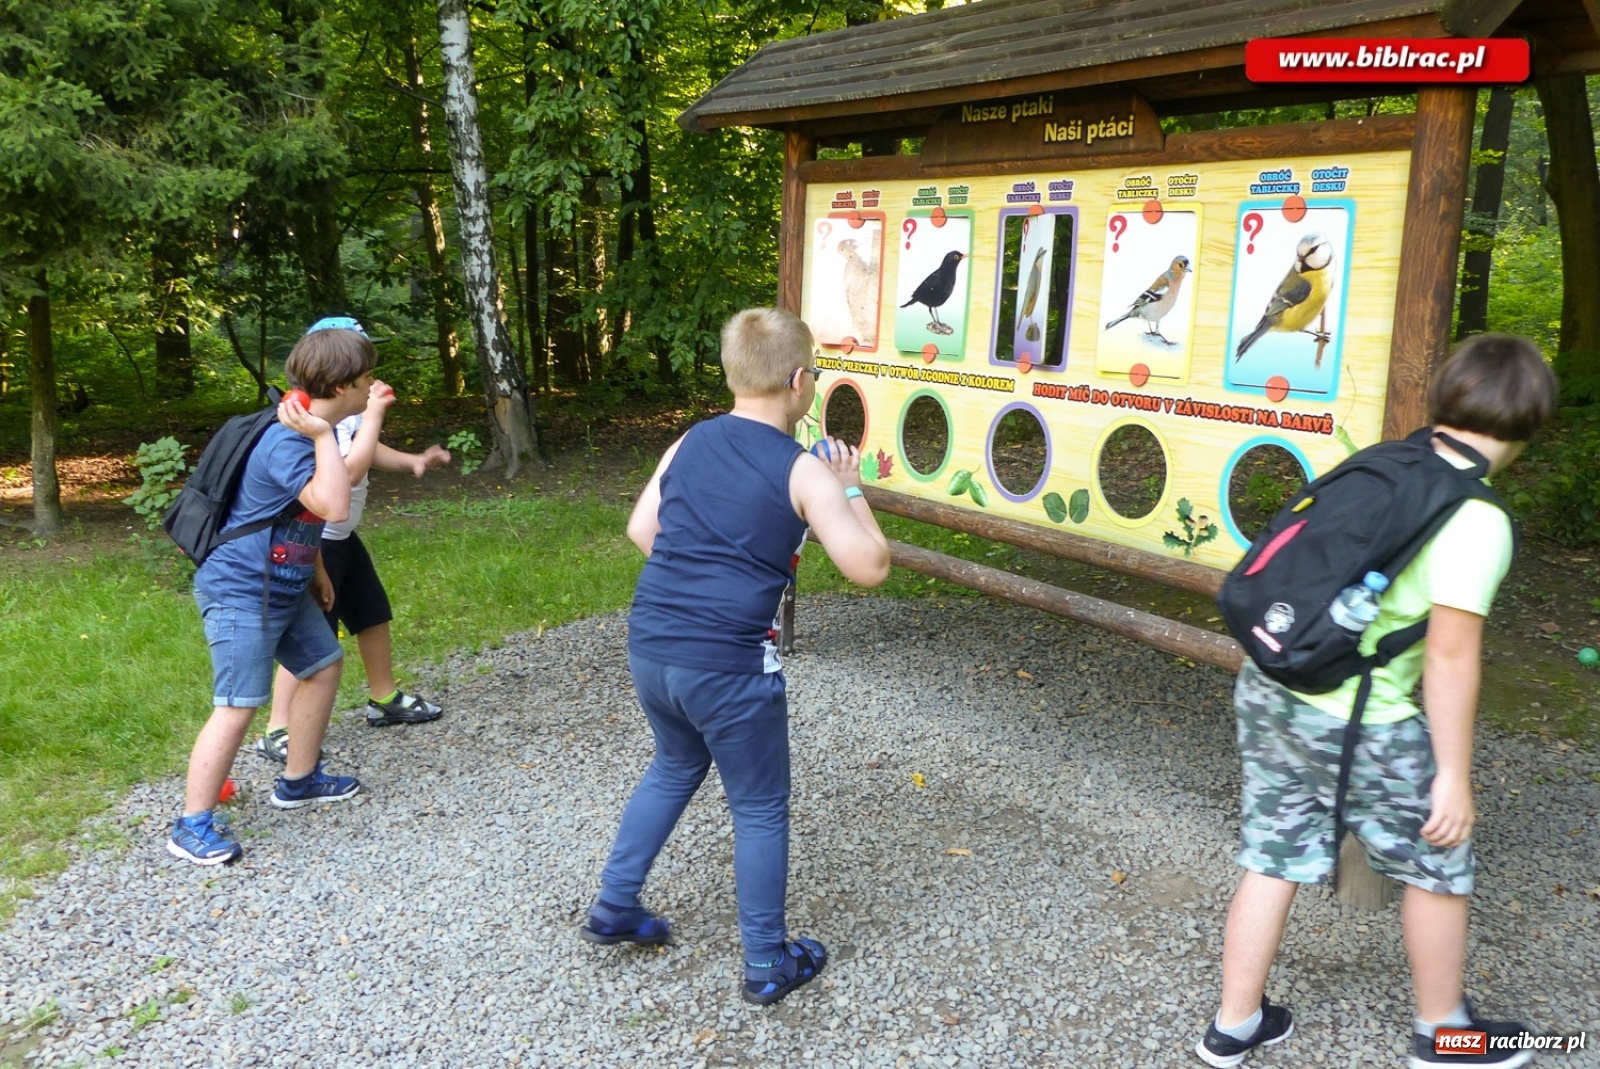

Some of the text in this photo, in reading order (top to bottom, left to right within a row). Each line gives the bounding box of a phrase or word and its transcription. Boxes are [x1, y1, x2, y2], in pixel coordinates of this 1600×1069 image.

[962, 95, 1054, 123] Nasze ptaki
[1044, 115, 1134, 144] Naši ptáci
[1260, 169, 1292, 182] OBRÓĆ
[1312, 166, 1349, 180] OTOČIT
[1125, 176, 1151, 188] OBRÓĆ
[1168, 174, 1198, 186] OTOČIT
[1168, 187, 1195, 197] DESKU
[1250, 183, 1300, 195] TABLICZKĘ
[1312, 181, 1345, 192] DESKU
[1118, 188, 1158, 200] TABLICZKĘ
[843, 359, 879, 378] PIŁECZKĘ
[880, 364, 889, 377] W
[890, 364, 919, 381] OTWÓR
[920, 368, 960, 386] ZGODNIE
[960, 372, 967, 386] Z
[969, 374, 1015, 393] KOLOREM
[1032, 382, 1333, 435] HODIT MÍČ DO OTVORU V ZÁVISLOSTI NA BARVĚ
